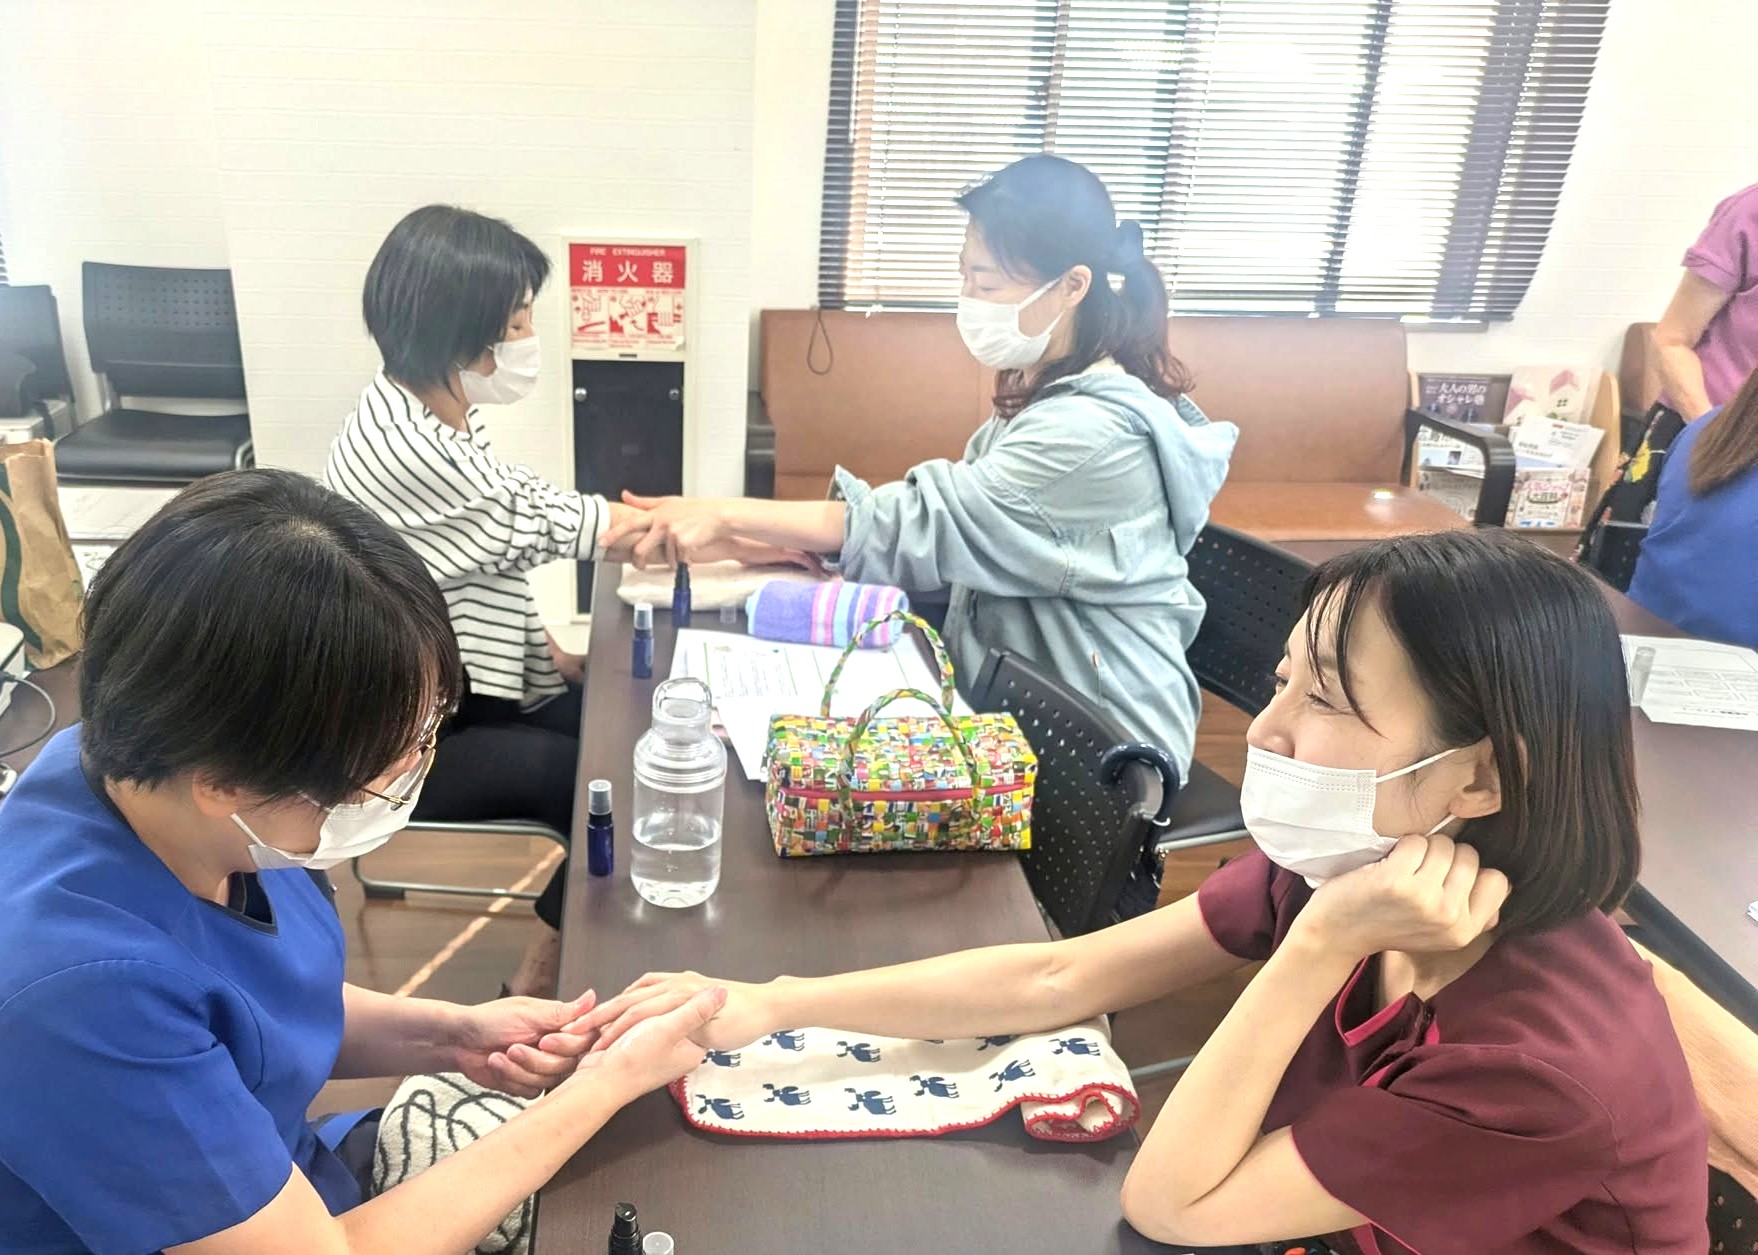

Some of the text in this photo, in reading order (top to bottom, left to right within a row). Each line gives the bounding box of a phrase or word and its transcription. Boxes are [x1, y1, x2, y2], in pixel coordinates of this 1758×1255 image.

[590, 247, 606, 256] FIRE
[582, 259, 673, 283] 消火器
